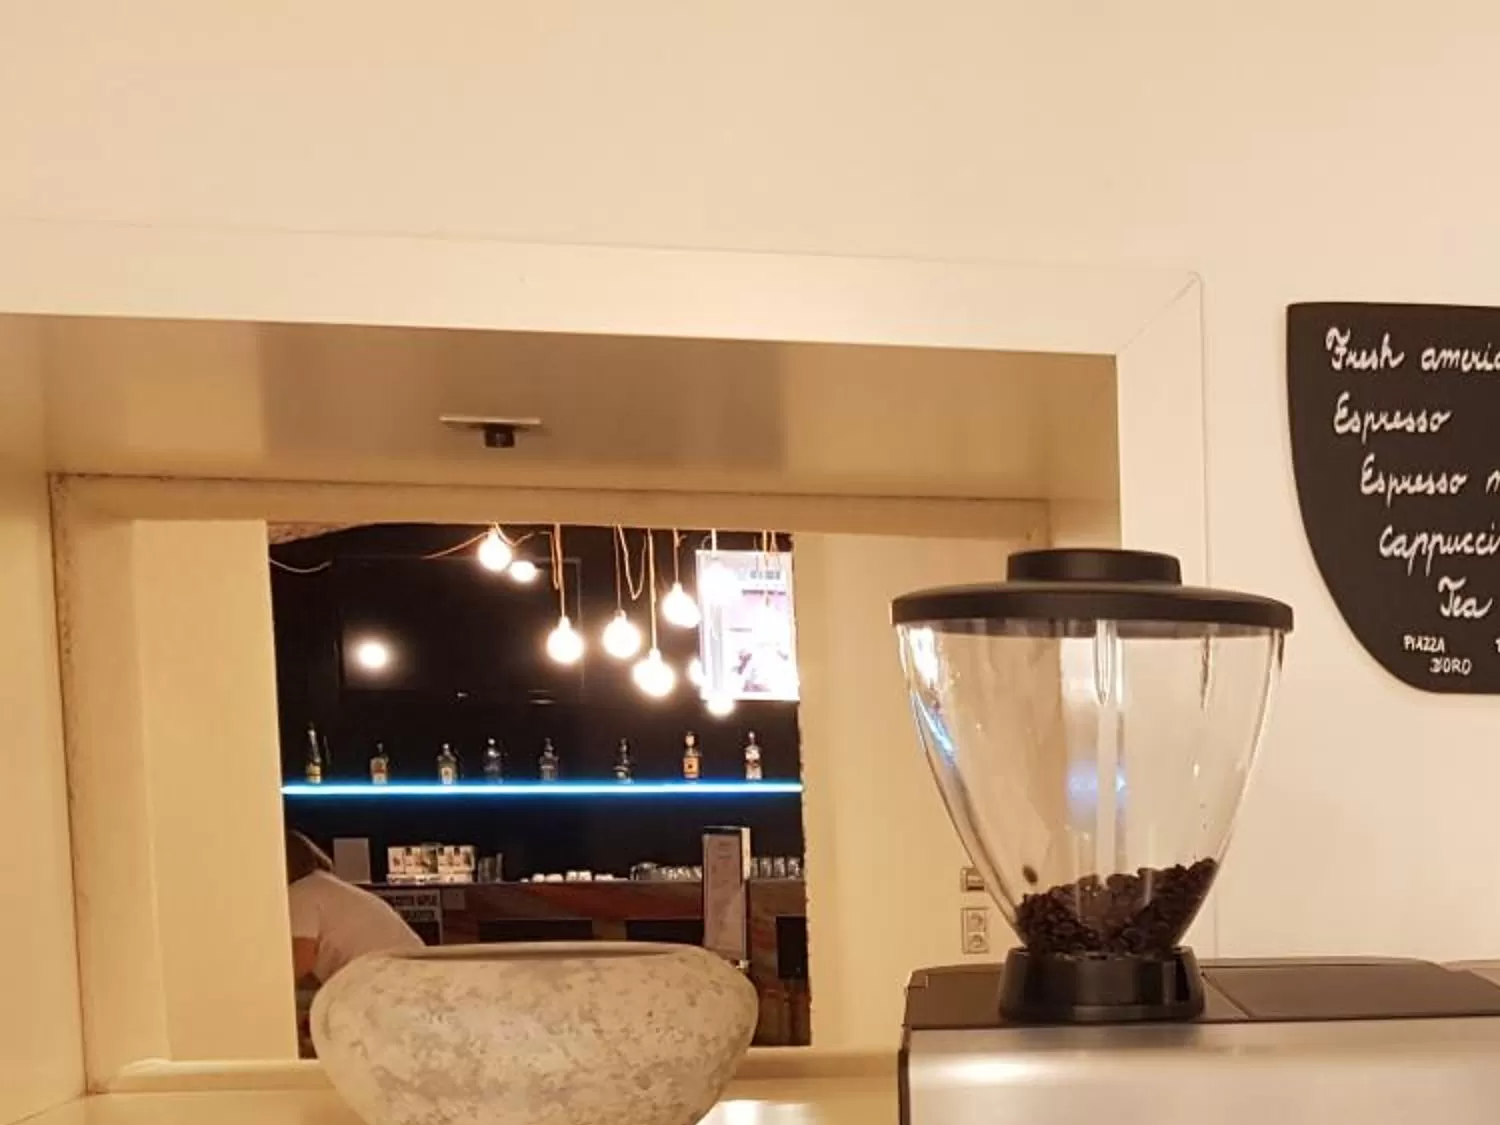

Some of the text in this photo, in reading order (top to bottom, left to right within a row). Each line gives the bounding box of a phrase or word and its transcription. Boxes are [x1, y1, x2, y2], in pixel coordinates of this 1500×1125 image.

[1325, 326, 1405, 371] Fresh
[1333, 391, 1452, 444] Espresso
[1360, 452, 1468, 507] Espresso
[1437, 575, 1493, 619] Tea
[1403, 634, 1446, 653] PIAZZA
